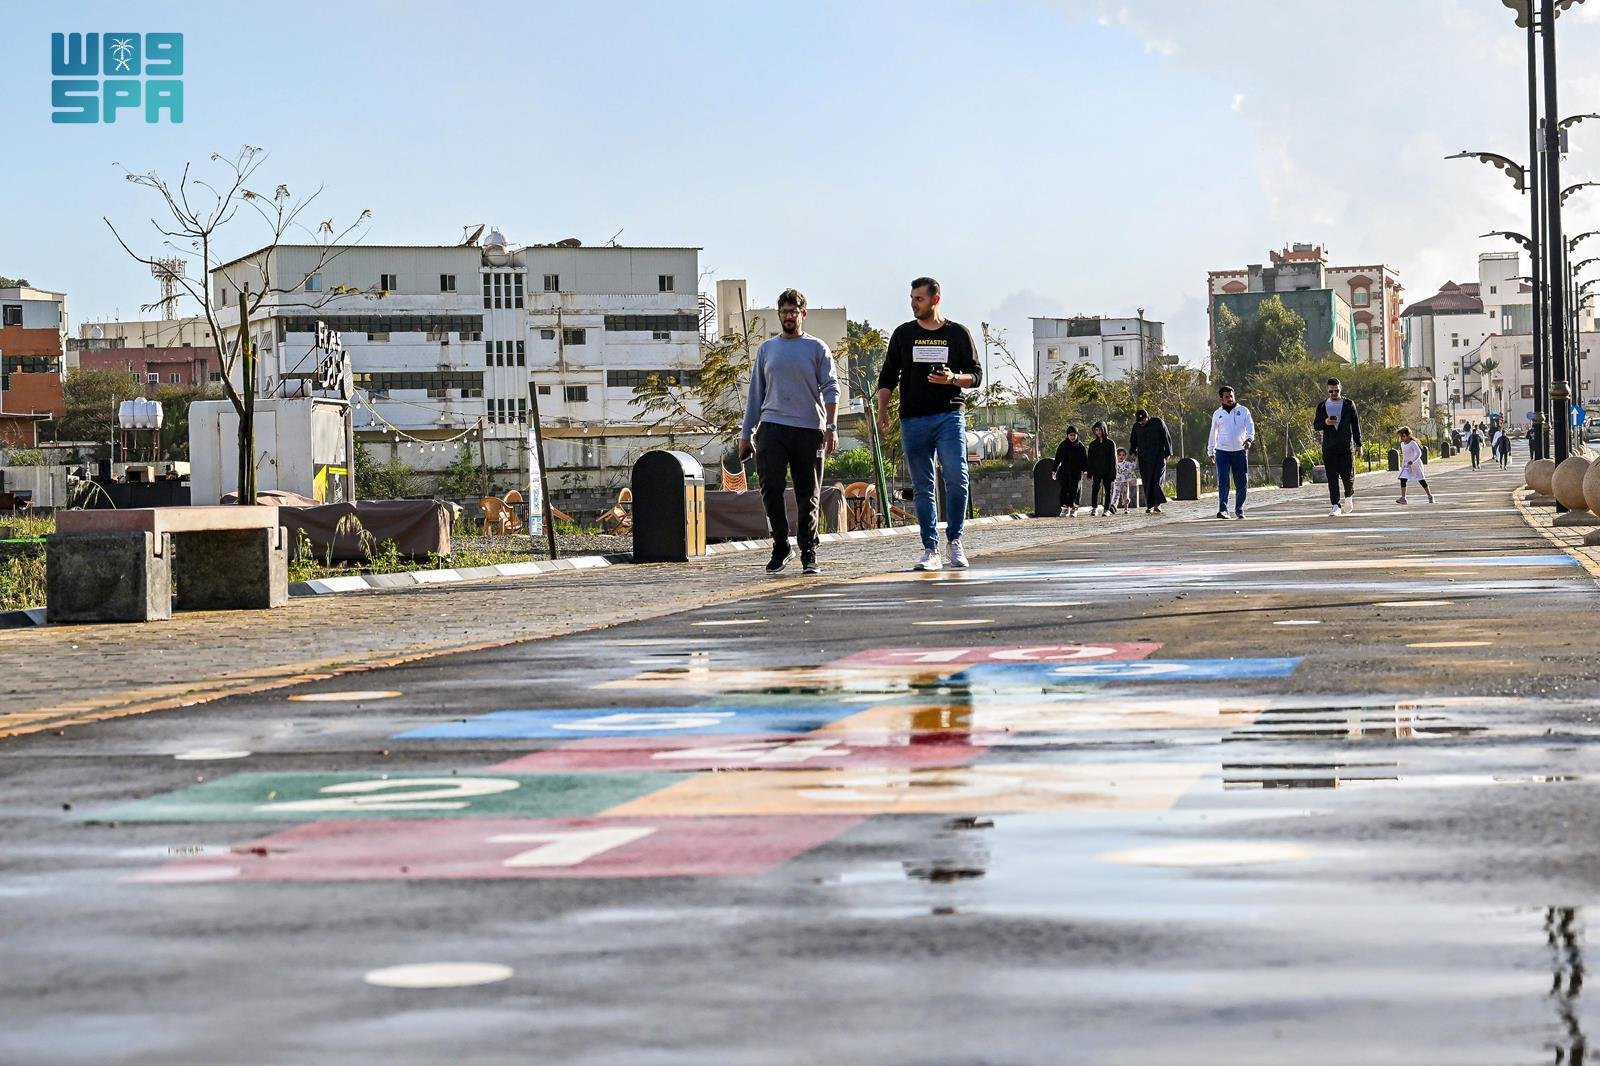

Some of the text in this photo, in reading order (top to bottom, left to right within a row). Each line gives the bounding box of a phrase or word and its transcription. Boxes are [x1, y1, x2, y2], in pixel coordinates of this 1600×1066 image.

[891, 647, 1118, 661] 10
[552, 711, 736, 731] 5
[651, 739, 850, 764] 4
[253, 777, 520, 811] 2
[486, 827, 658, 867] 1
